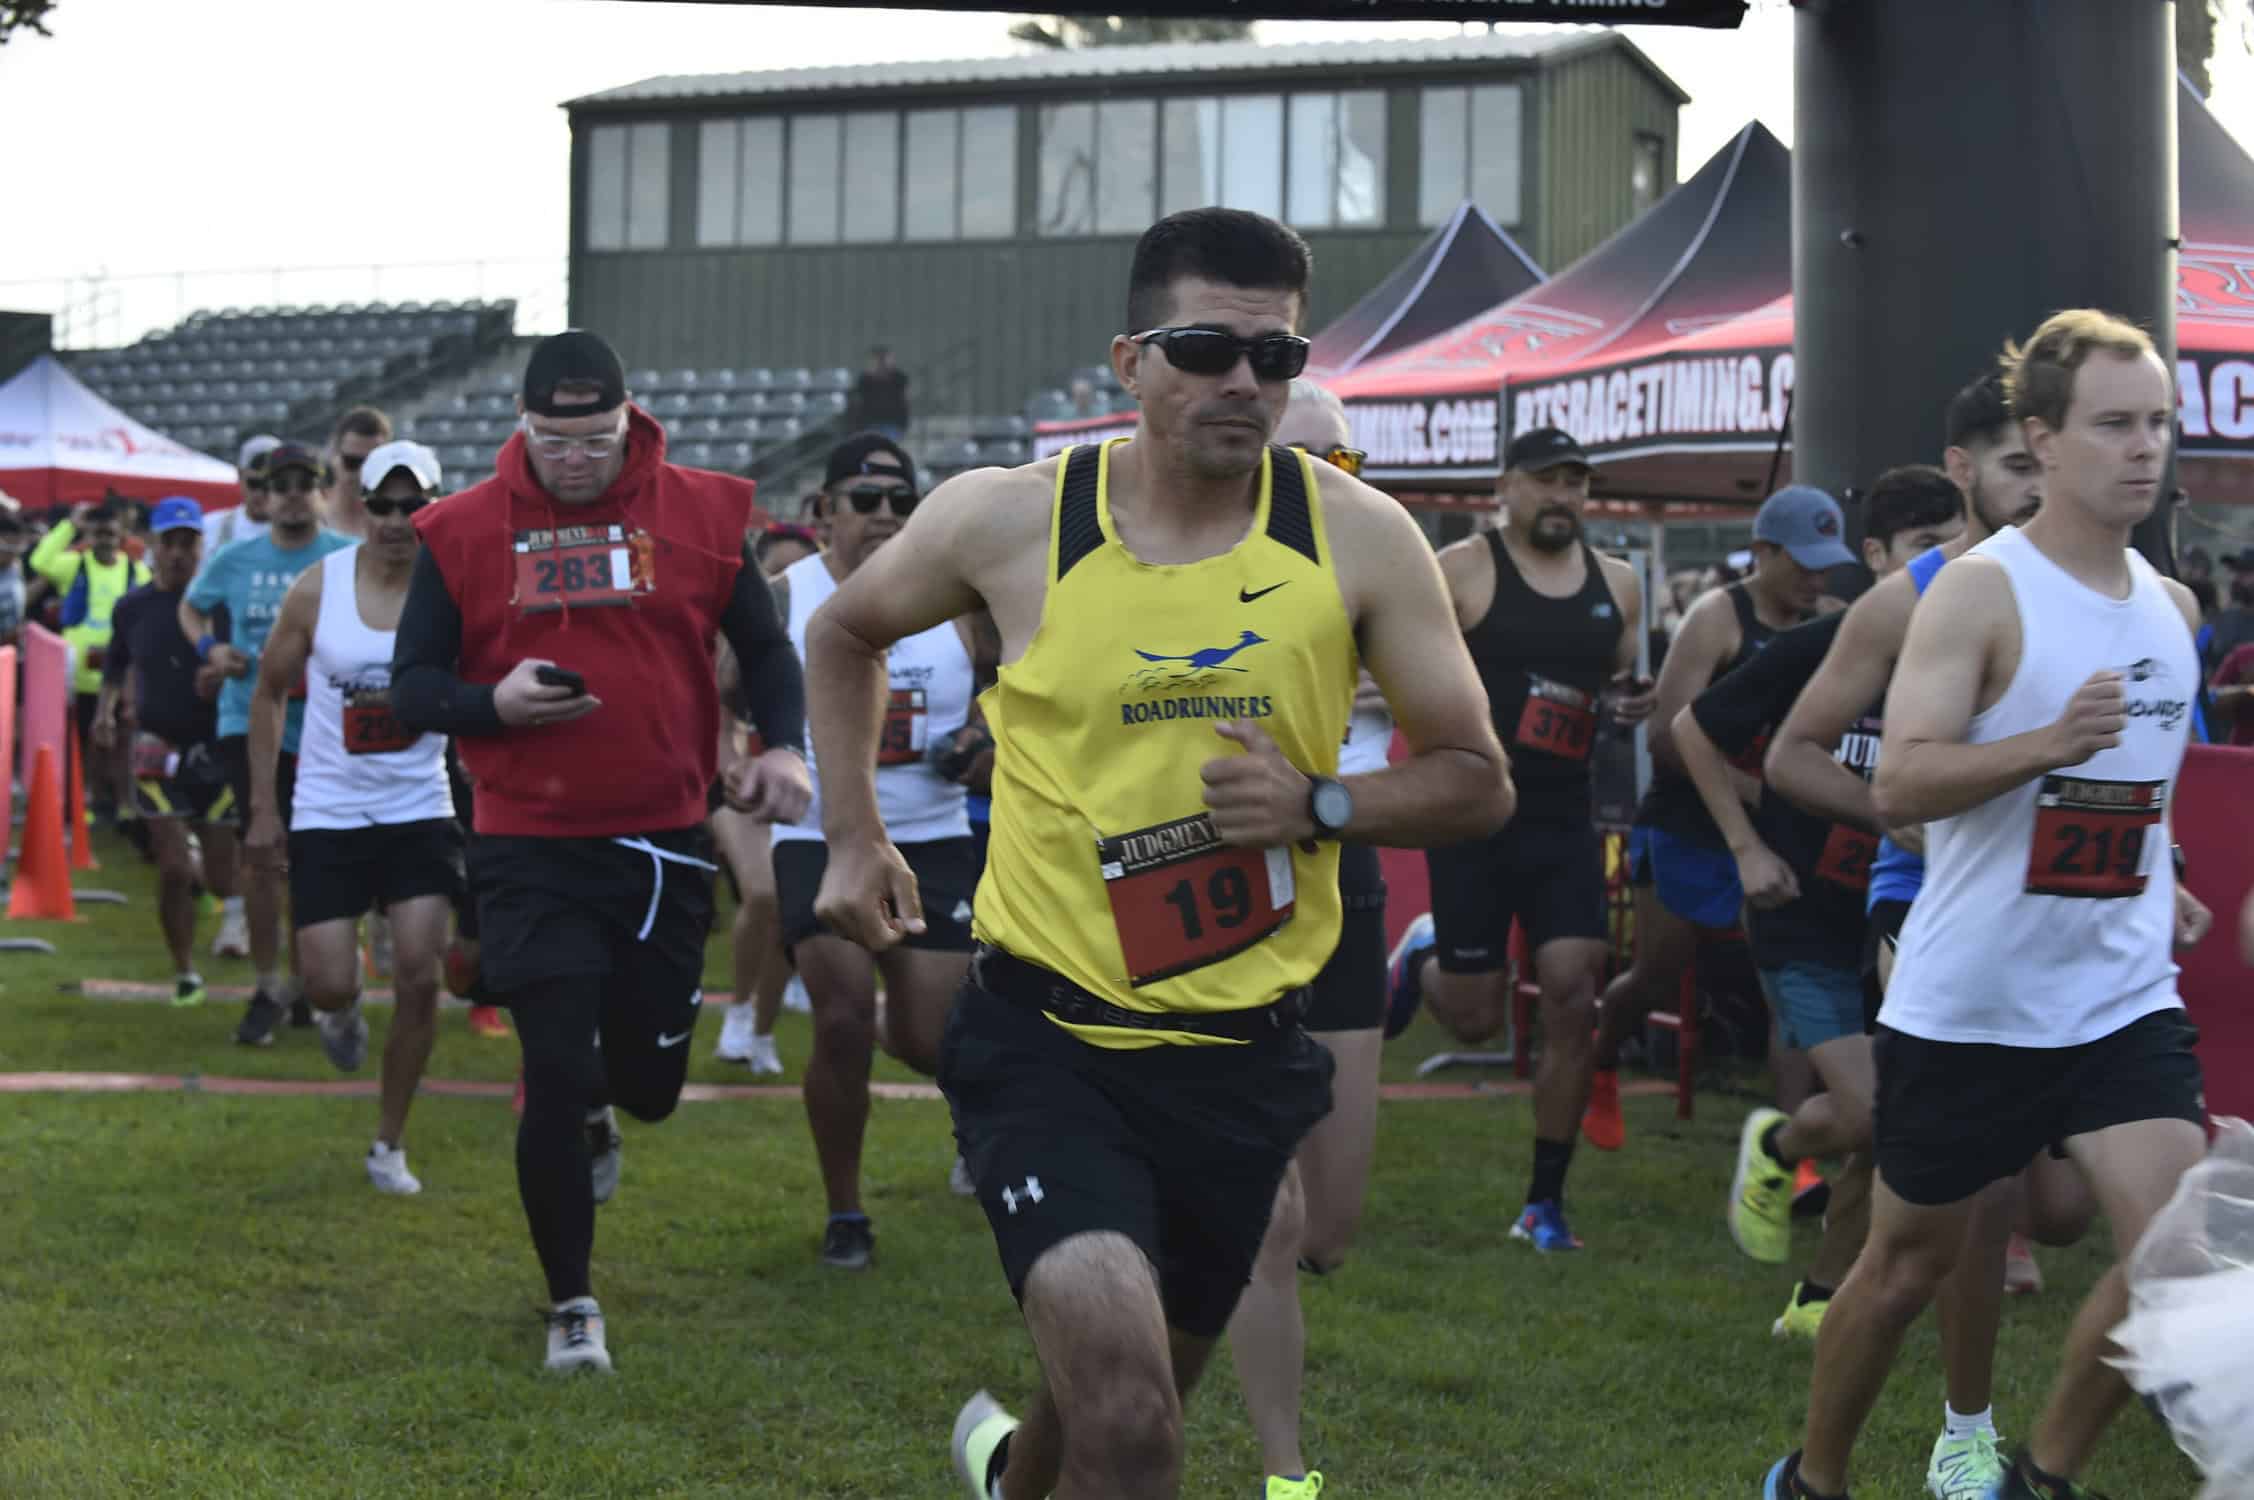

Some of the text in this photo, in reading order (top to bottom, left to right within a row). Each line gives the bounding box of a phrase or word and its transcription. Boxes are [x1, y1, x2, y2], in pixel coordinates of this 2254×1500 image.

[535, 553, 611, 593] 283
[1121, 695, 1273, 725] ROADRUNNERS
[2050, 823, 2146, 877] 219
[1165, 866, 1251, 942] 19
